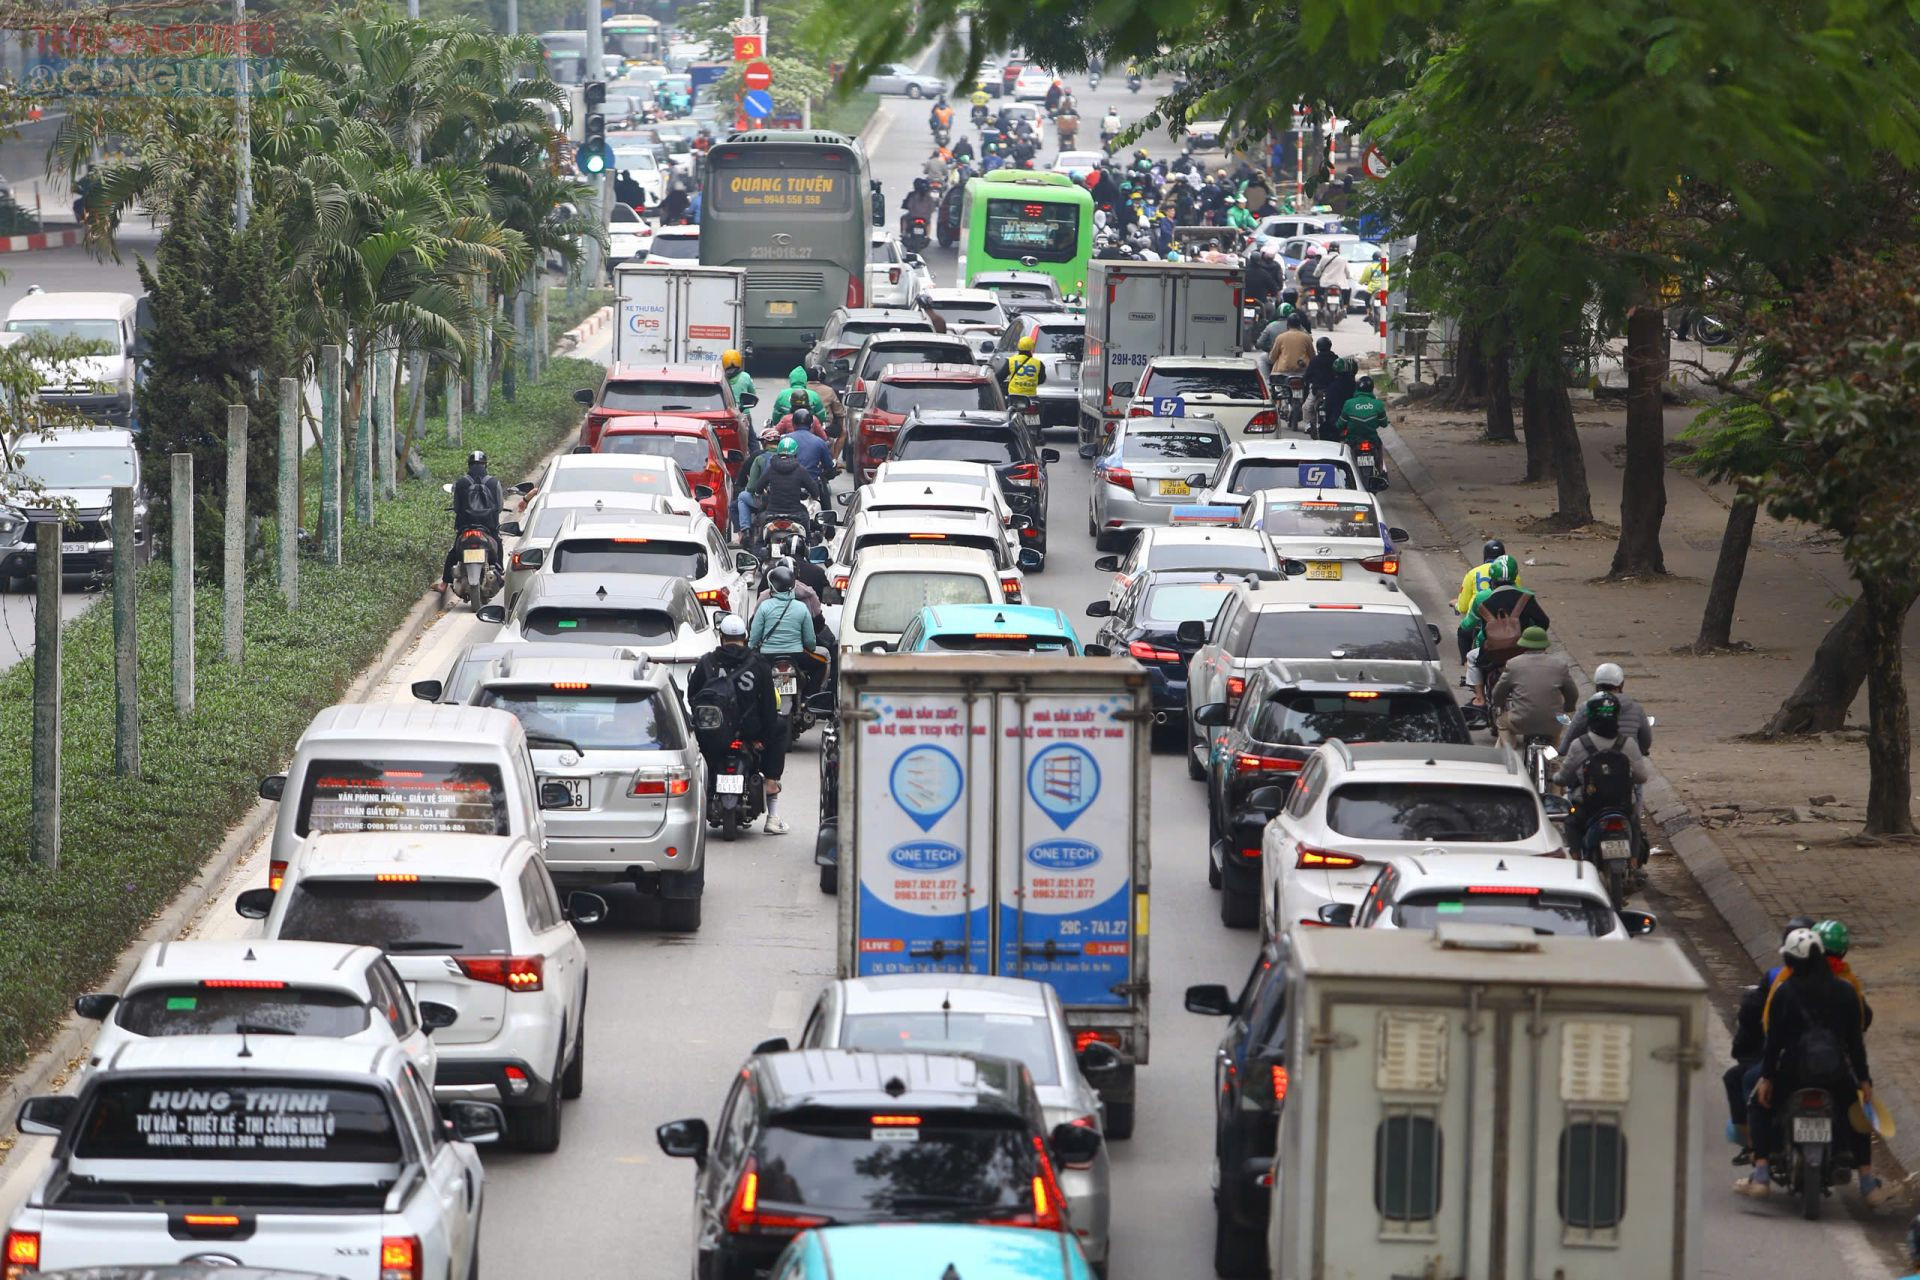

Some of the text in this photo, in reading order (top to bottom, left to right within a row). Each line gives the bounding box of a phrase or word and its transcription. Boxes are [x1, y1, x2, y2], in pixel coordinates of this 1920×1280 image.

[731, 176, 782, 193] QUANG
[637, 319, 660, 328] PCS
[1014, 360, 1037, 377] be
[1161, 399, 1177, 415] G7
[1307, 467, 1327, 486] G7
[895, 849, 957, 861] ONE TECH
[1033, 848, 1095, 860] ONE TECH
[1091, 920, 1127, 935] 741.27
[149, 1088, 329, 1115] HƯNG THỊNH
[245, 1116, 264, 1133] THI
[266, 1112, 299, 1134] CÔNG
[335, 1247, 370, 1257] XLS
